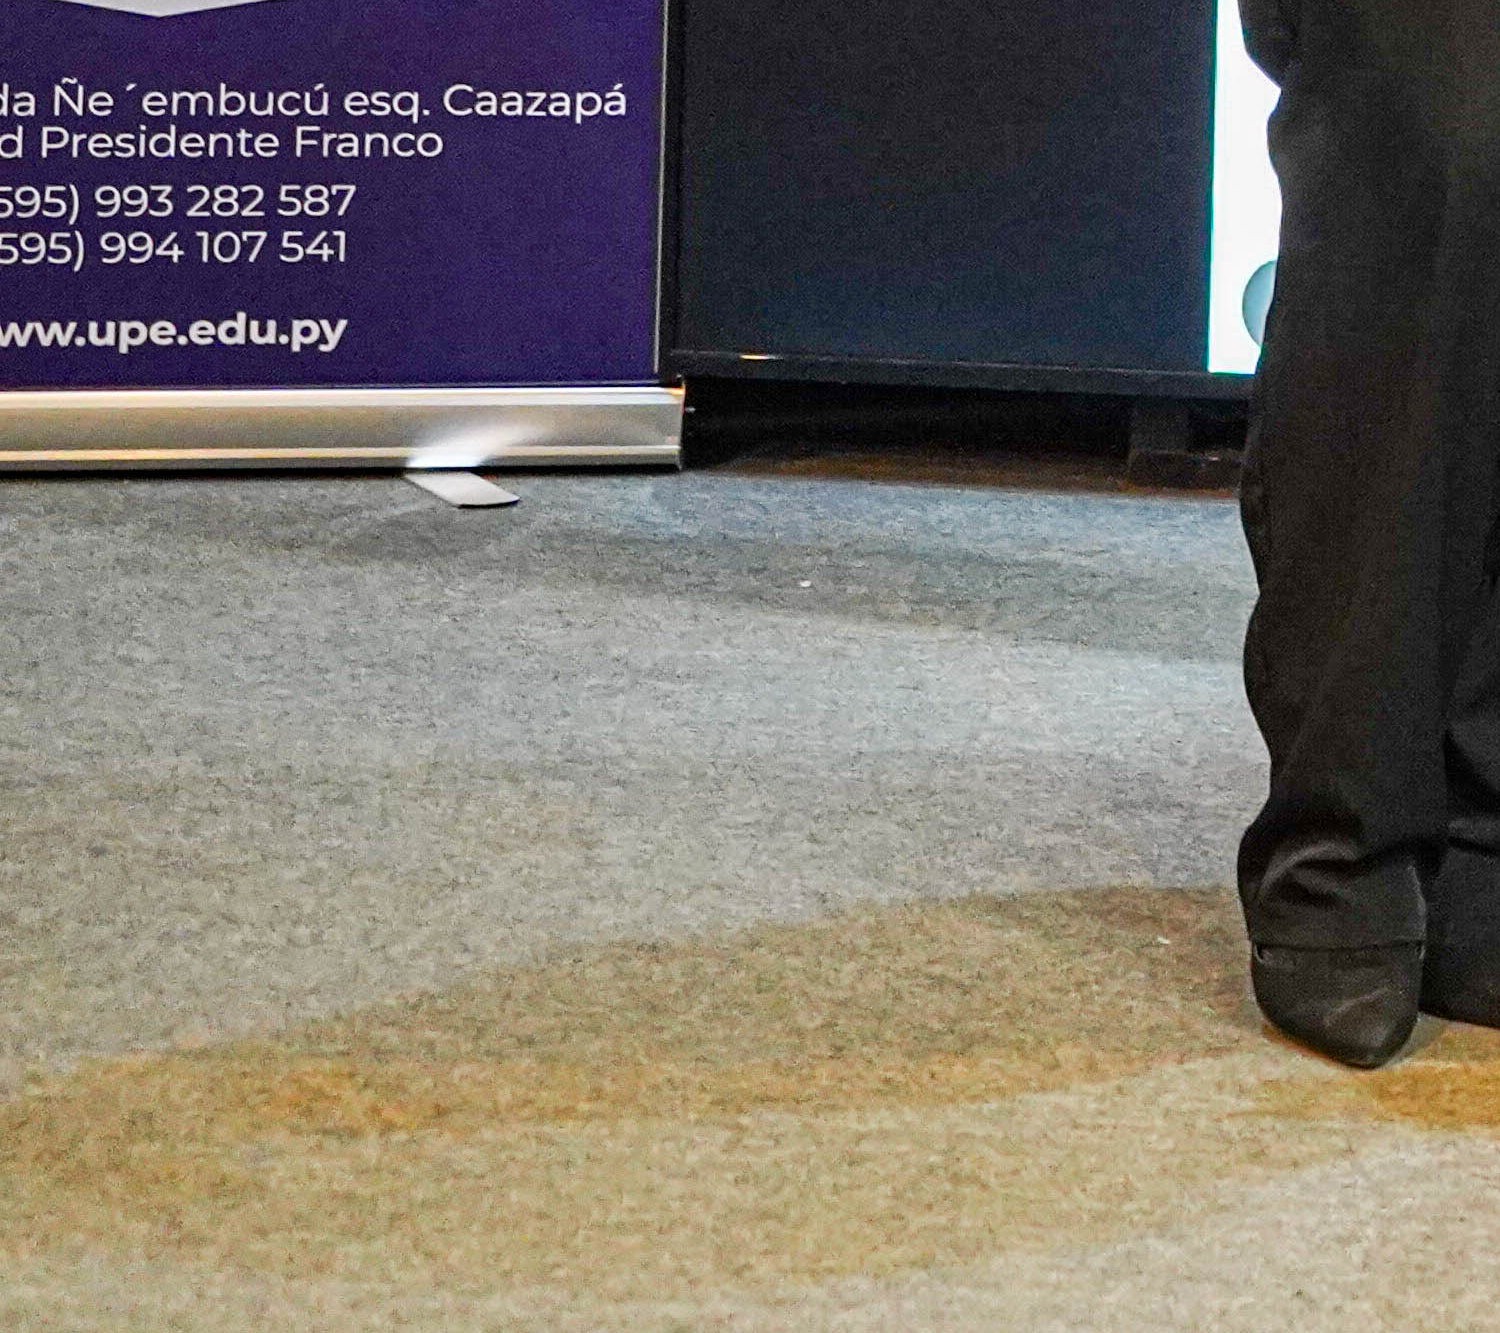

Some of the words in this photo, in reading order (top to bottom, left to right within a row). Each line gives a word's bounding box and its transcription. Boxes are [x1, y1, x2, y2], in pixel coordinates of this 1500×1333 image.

[343, 86, 432, 123] esq.
[443, 83, 628, 124] Caazapá
[41, 124, 280, 159] Presidente
[295, 125, 444, 160] Franco
[94, 184, 174, 218] 993
[186, 184, 266, 218] 282
[276, 184, 357, 217] 587
[100, 231, 185, 265] 994
[195, 231, 268, 264] 107
[278, 231, 347, 264] 541
